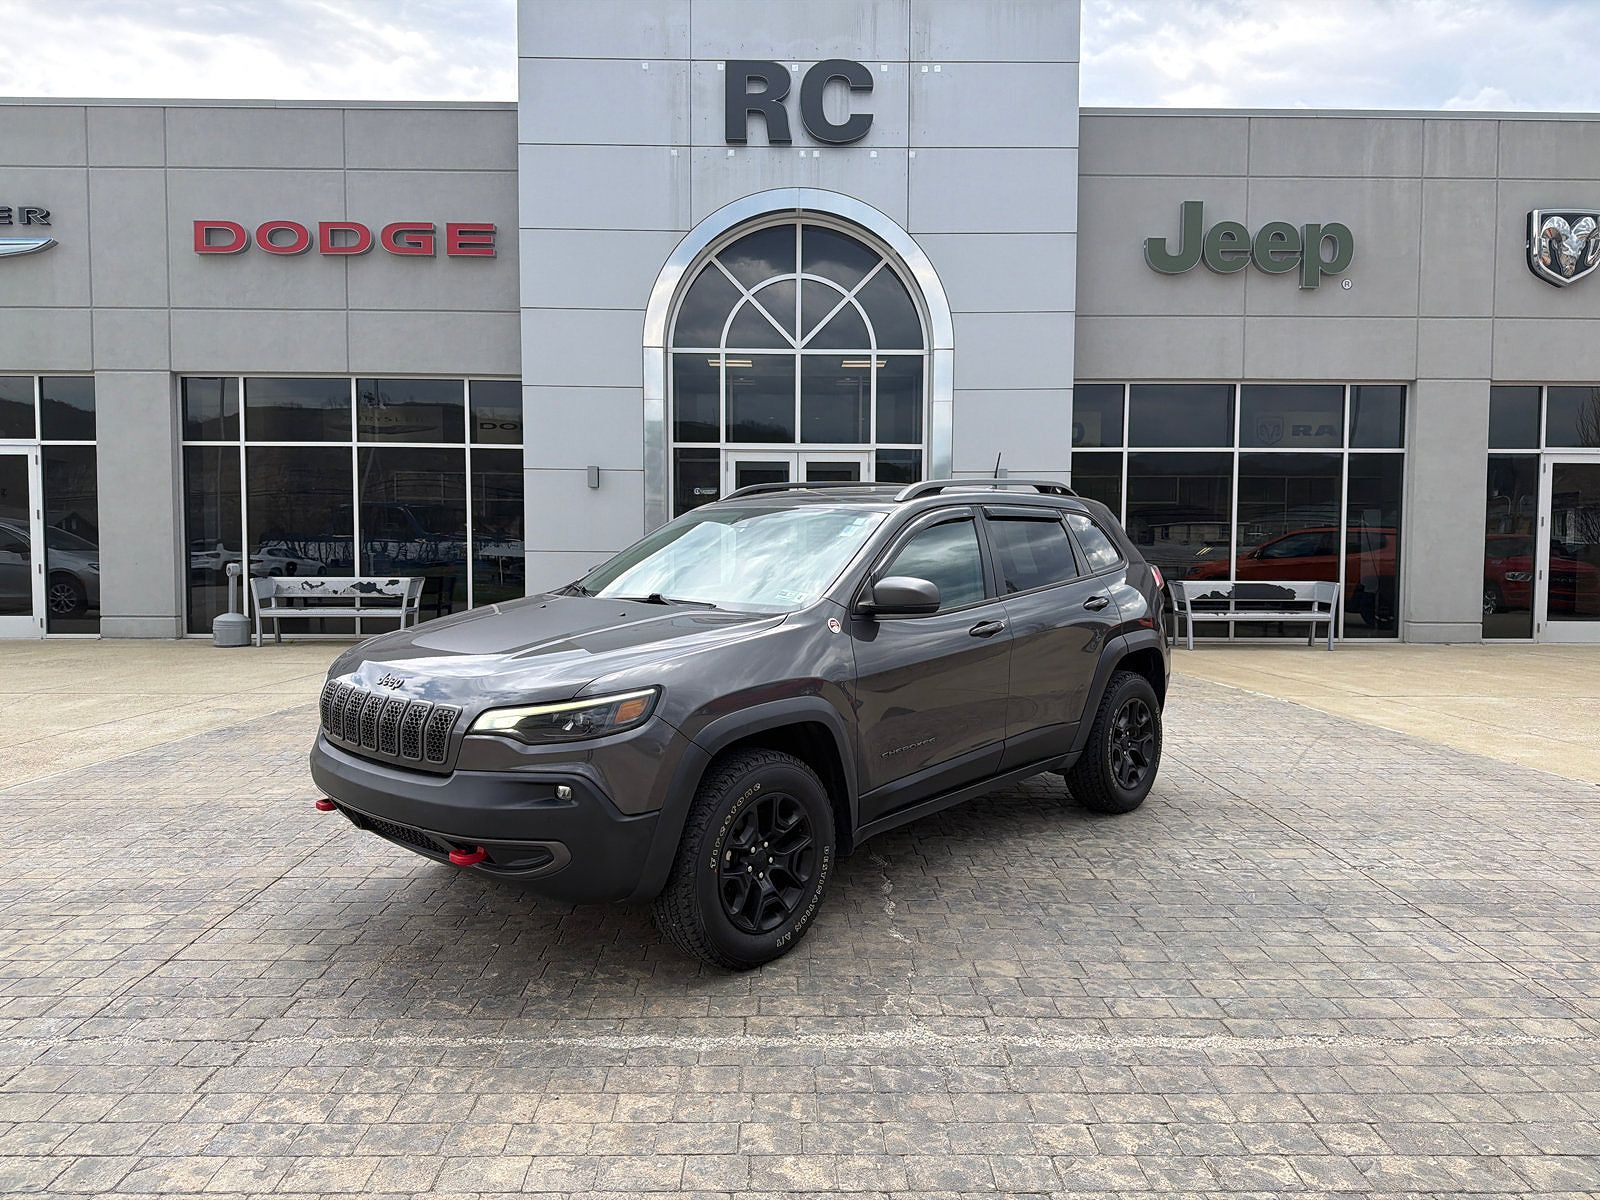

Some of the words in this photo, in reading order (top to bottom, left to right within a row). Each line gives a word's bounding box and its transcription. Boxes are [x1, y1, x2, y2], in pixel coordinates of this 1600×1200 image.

[725, 58, 874, 145] RC
[193, 220, 498, 257] DODGE
[1144, 200, 1355, 289] Jeep
[376, 672, 405, 691] Jeep
